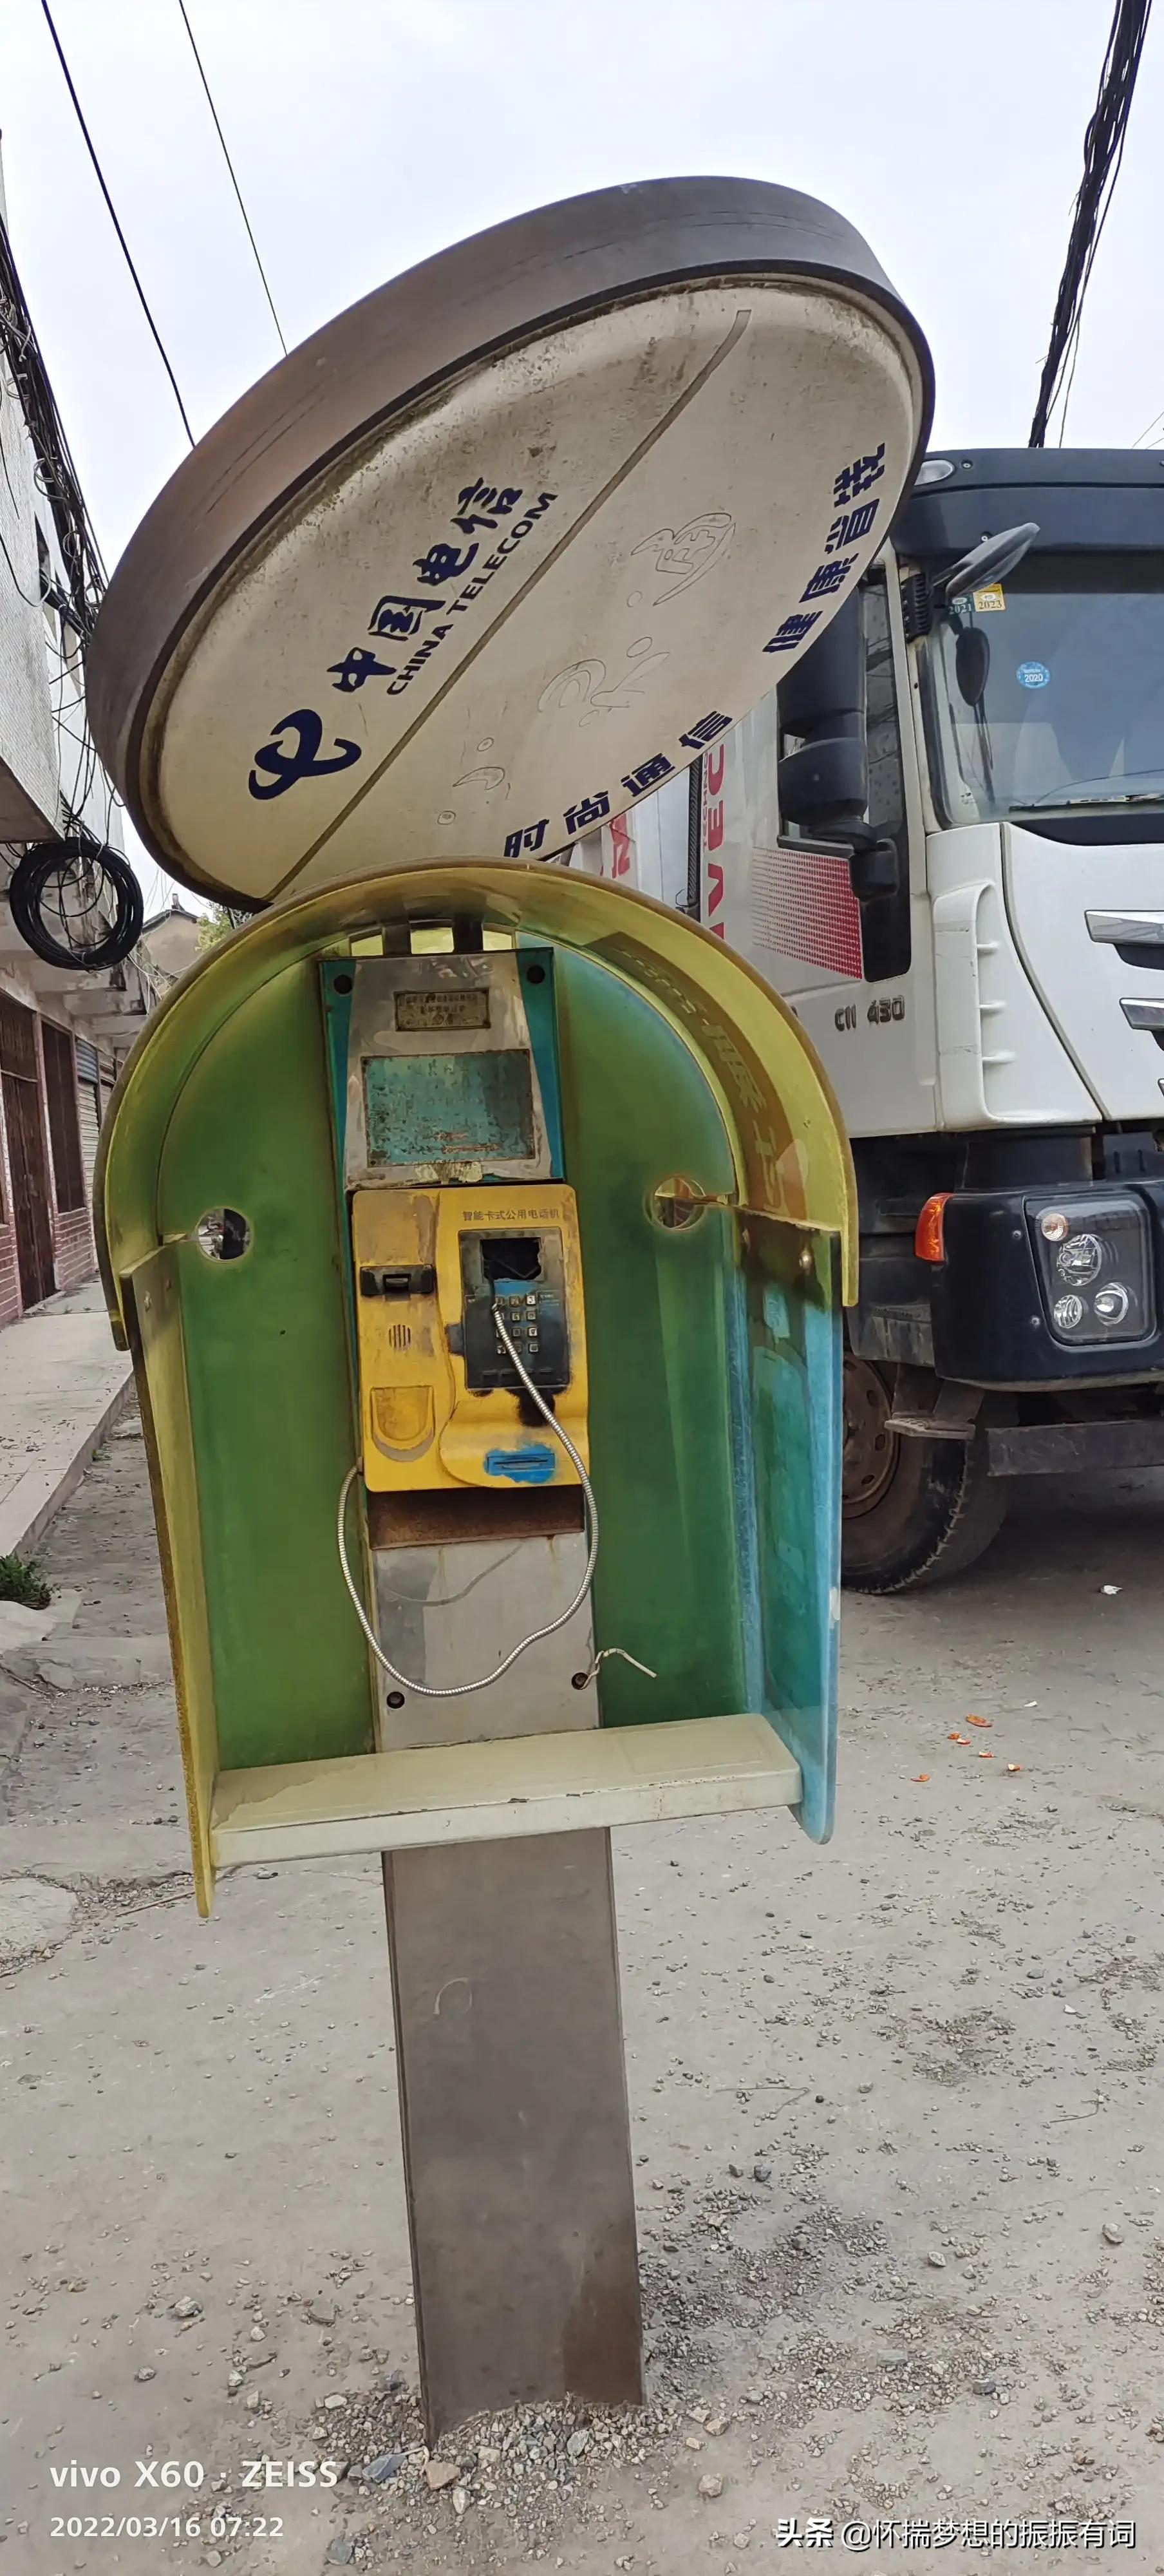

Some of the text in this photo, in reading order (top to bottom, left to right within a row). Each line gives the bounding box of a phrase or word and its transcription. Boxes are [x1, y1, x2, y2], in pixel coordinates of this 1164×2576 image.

[327, 477, 523, 692] 中国电信
[387, 493, 558, 694] CHINA TELECOM
[978, 600, 1002, 609] 2023
[1024, 673, 1044, 683] 2020
[504, 711, 732, 857] 时尚通信
[867, 994, 905, 1025] 430
[463, 1208, 559, 1221] 智能卡式公用电话机
